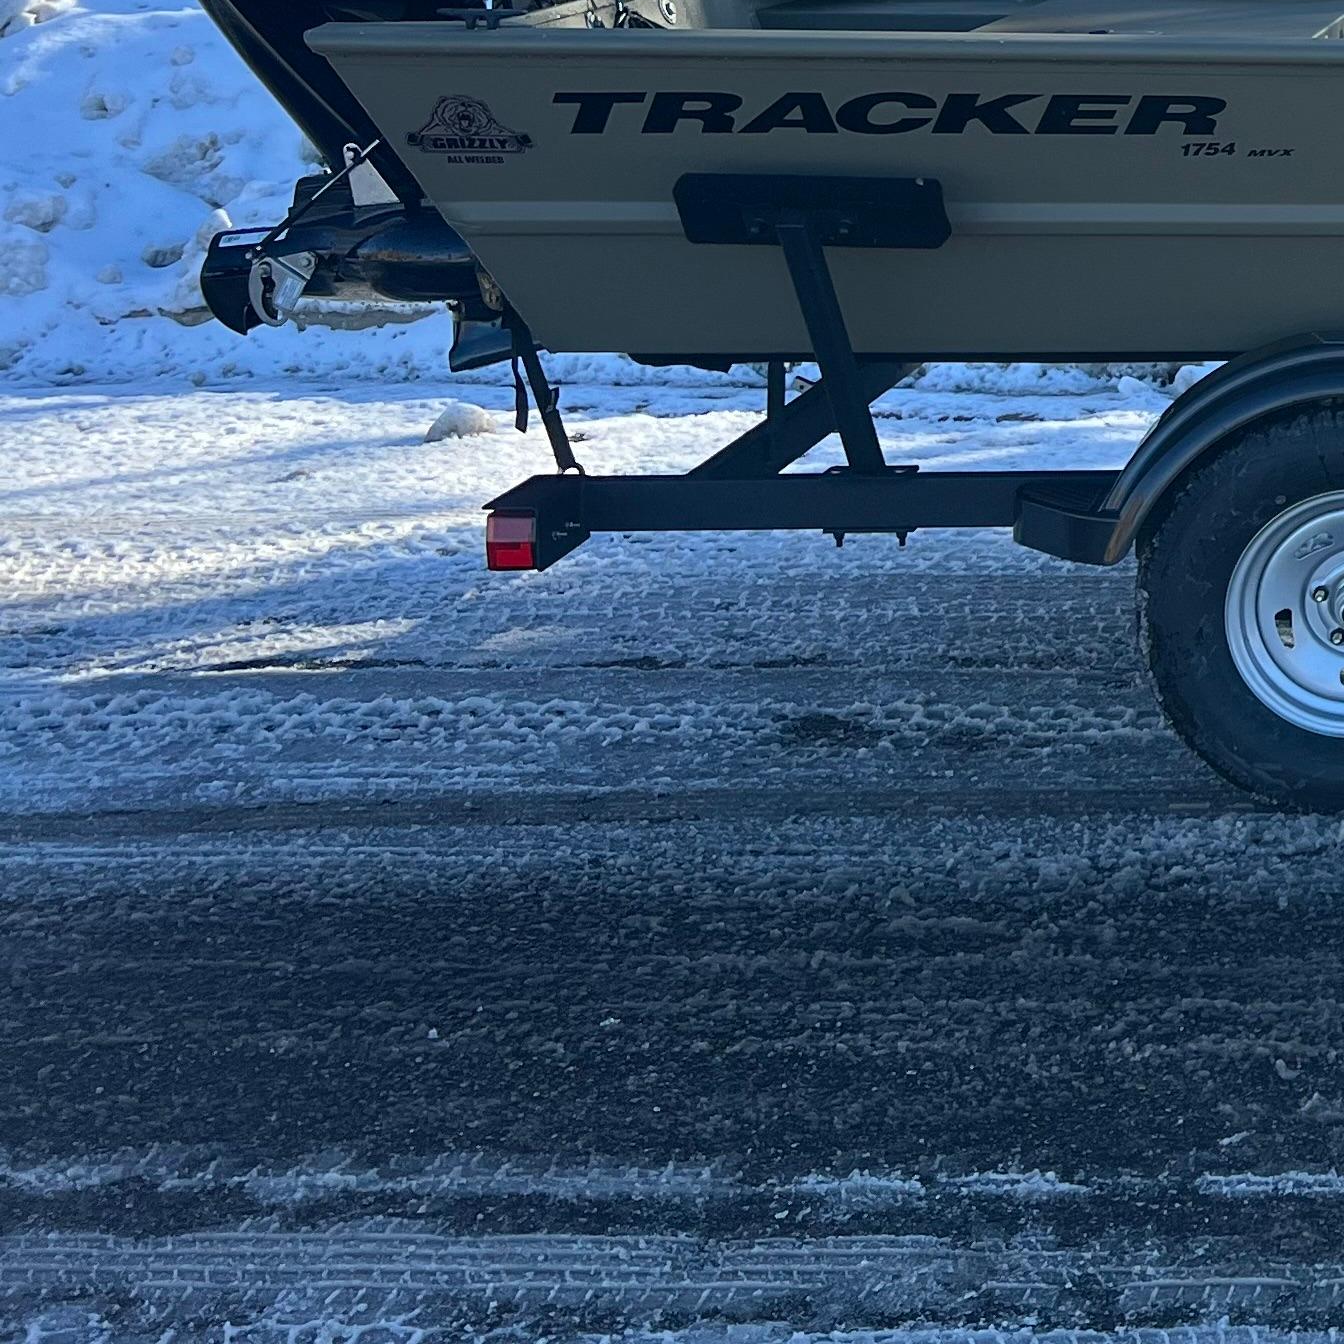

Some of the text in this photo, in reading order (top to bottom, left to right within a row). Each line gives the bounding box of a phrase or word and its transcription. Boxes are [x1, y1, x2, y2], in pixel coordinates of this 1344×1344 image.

[551, 91, 1228, 135] TRACKER
[431, 136, 508, 150] GRIZZLY
[1181, 142, 1296, 157] 1754 MVX
